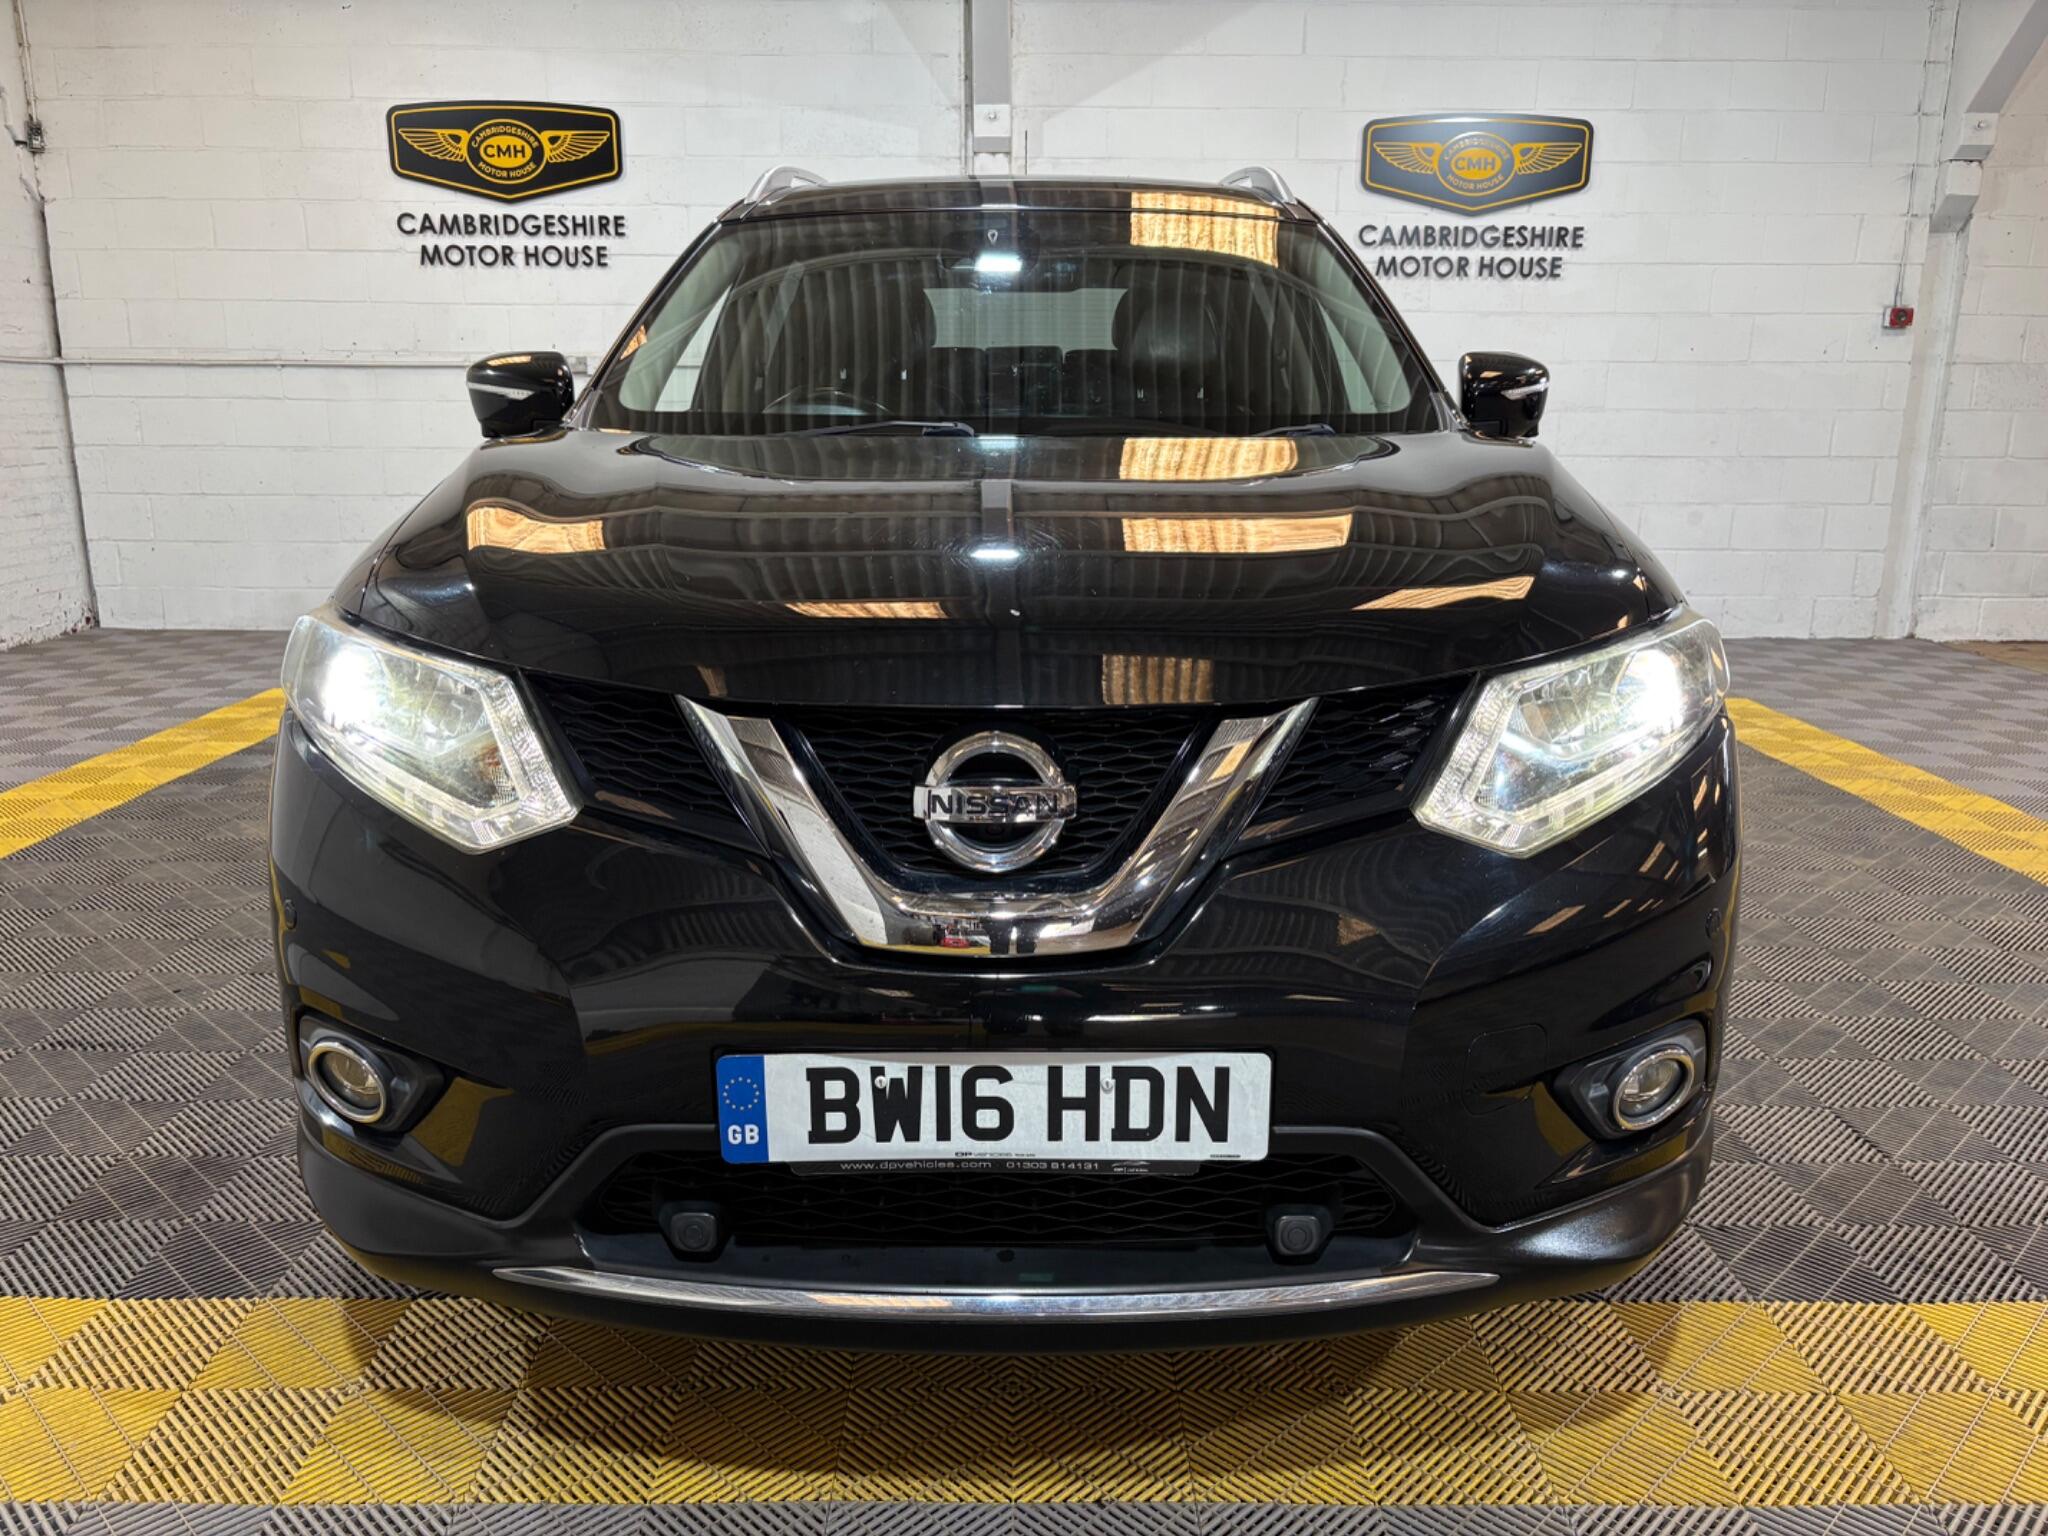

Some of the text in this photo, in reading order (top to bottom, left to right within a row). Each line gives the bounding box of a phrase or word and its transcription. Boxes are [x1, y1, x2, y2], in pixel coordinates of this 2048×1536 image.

[471, 125, 540, 149] CAMBRIDGESHIRE
[483, 144, 526, 158] CMH
[478, 161, 537, 178] MOTOR HOUSE
[1454, 157, 1496, 171] CMH
[1447, 174, 1505, 190] MOTOR HOUSE
[397, 212, 626, 237] CAMBRIDGESHIRE
[1358, 225, 1584, 248] CAMBRIDGESHIRE
[420, 245, 608, 267] MOTOR HOUSE
[1375, 256, 1562, 278] MOTOR HOUSE
[931, 793, 1058, 815] NISSAN
[806, 1065, 1229, 1144] BW16 HDN
[728, 1124, 760, 1146] GB
[840, 1160, 992, 1171] www.dpvehicles.com
[1006, 1161, 1047, 1169] 01303
